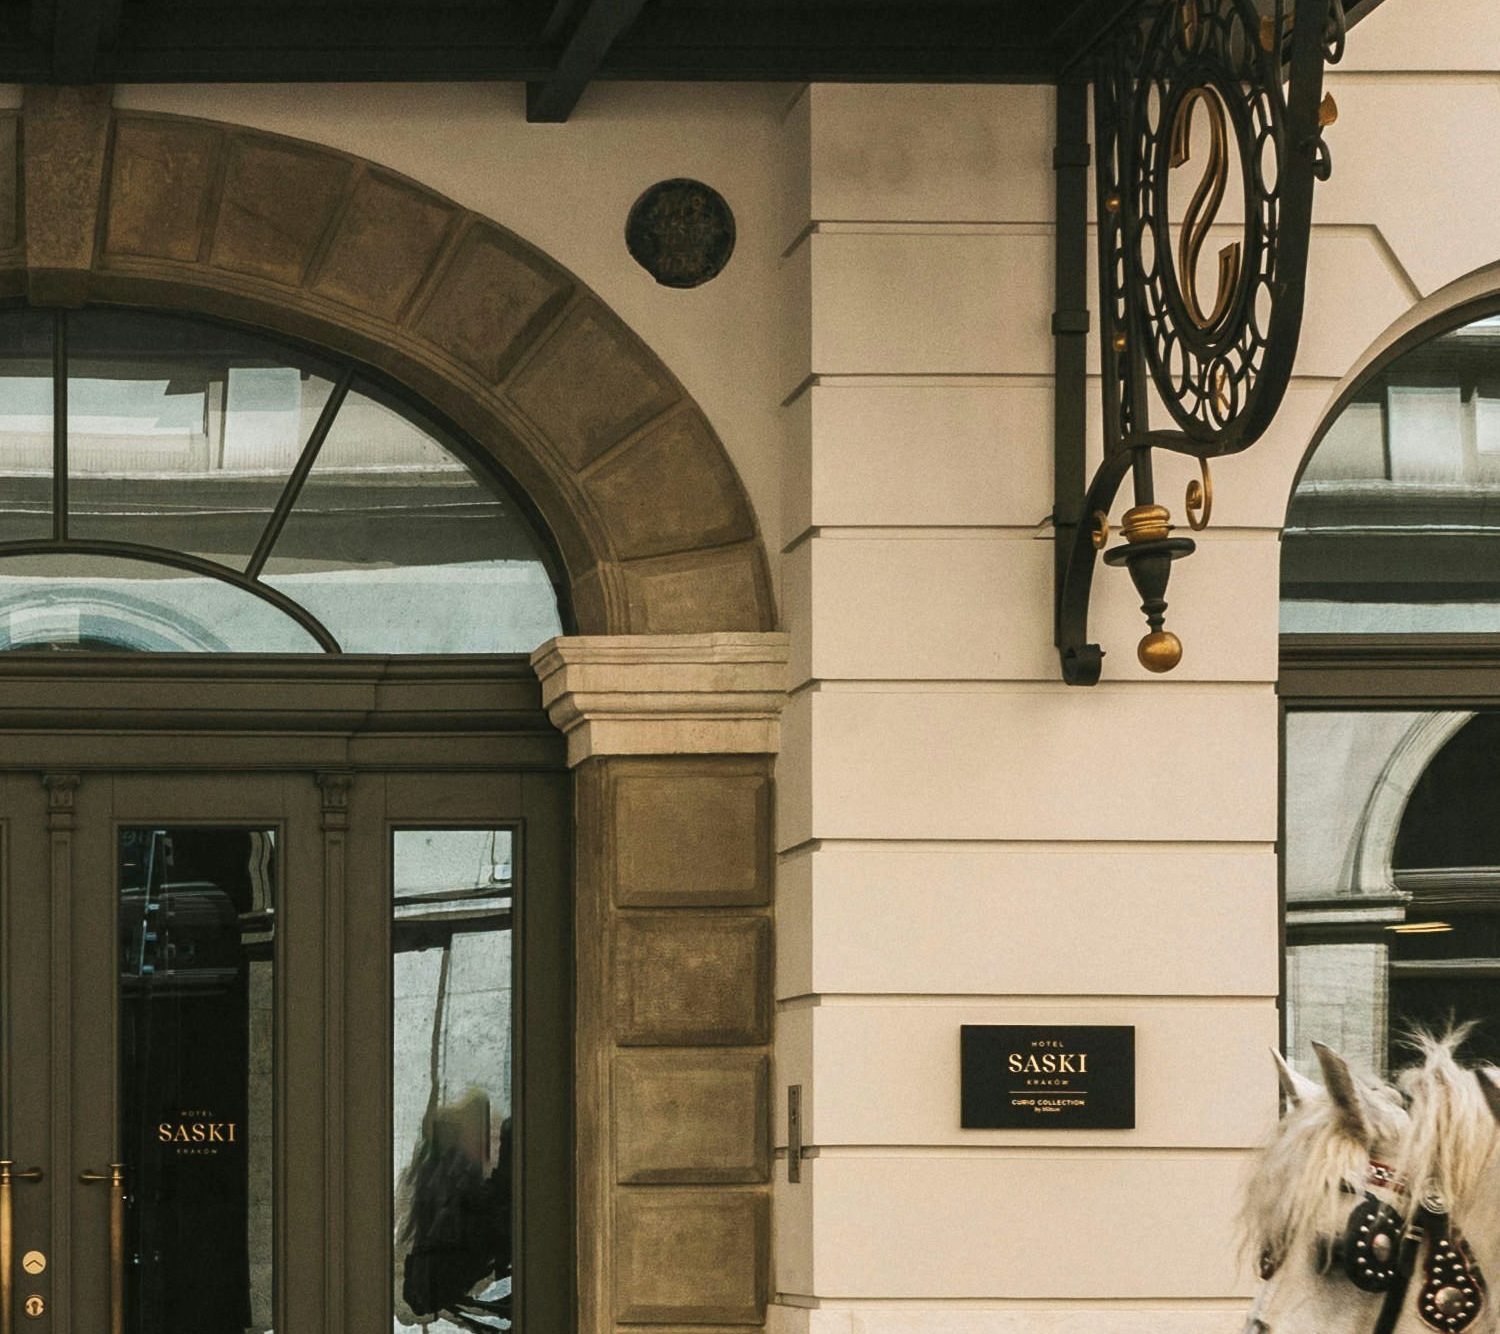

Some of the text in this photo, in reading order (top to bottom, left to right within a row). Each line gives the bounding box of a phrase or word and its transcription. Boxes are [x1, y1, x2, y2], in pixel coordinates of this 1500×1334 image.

[1031, 1040, 1064, 1048] HOTEL
[1008, 1053, 1088, 1073] SASKI
[158, 1123, 236, 1142] SASKI
